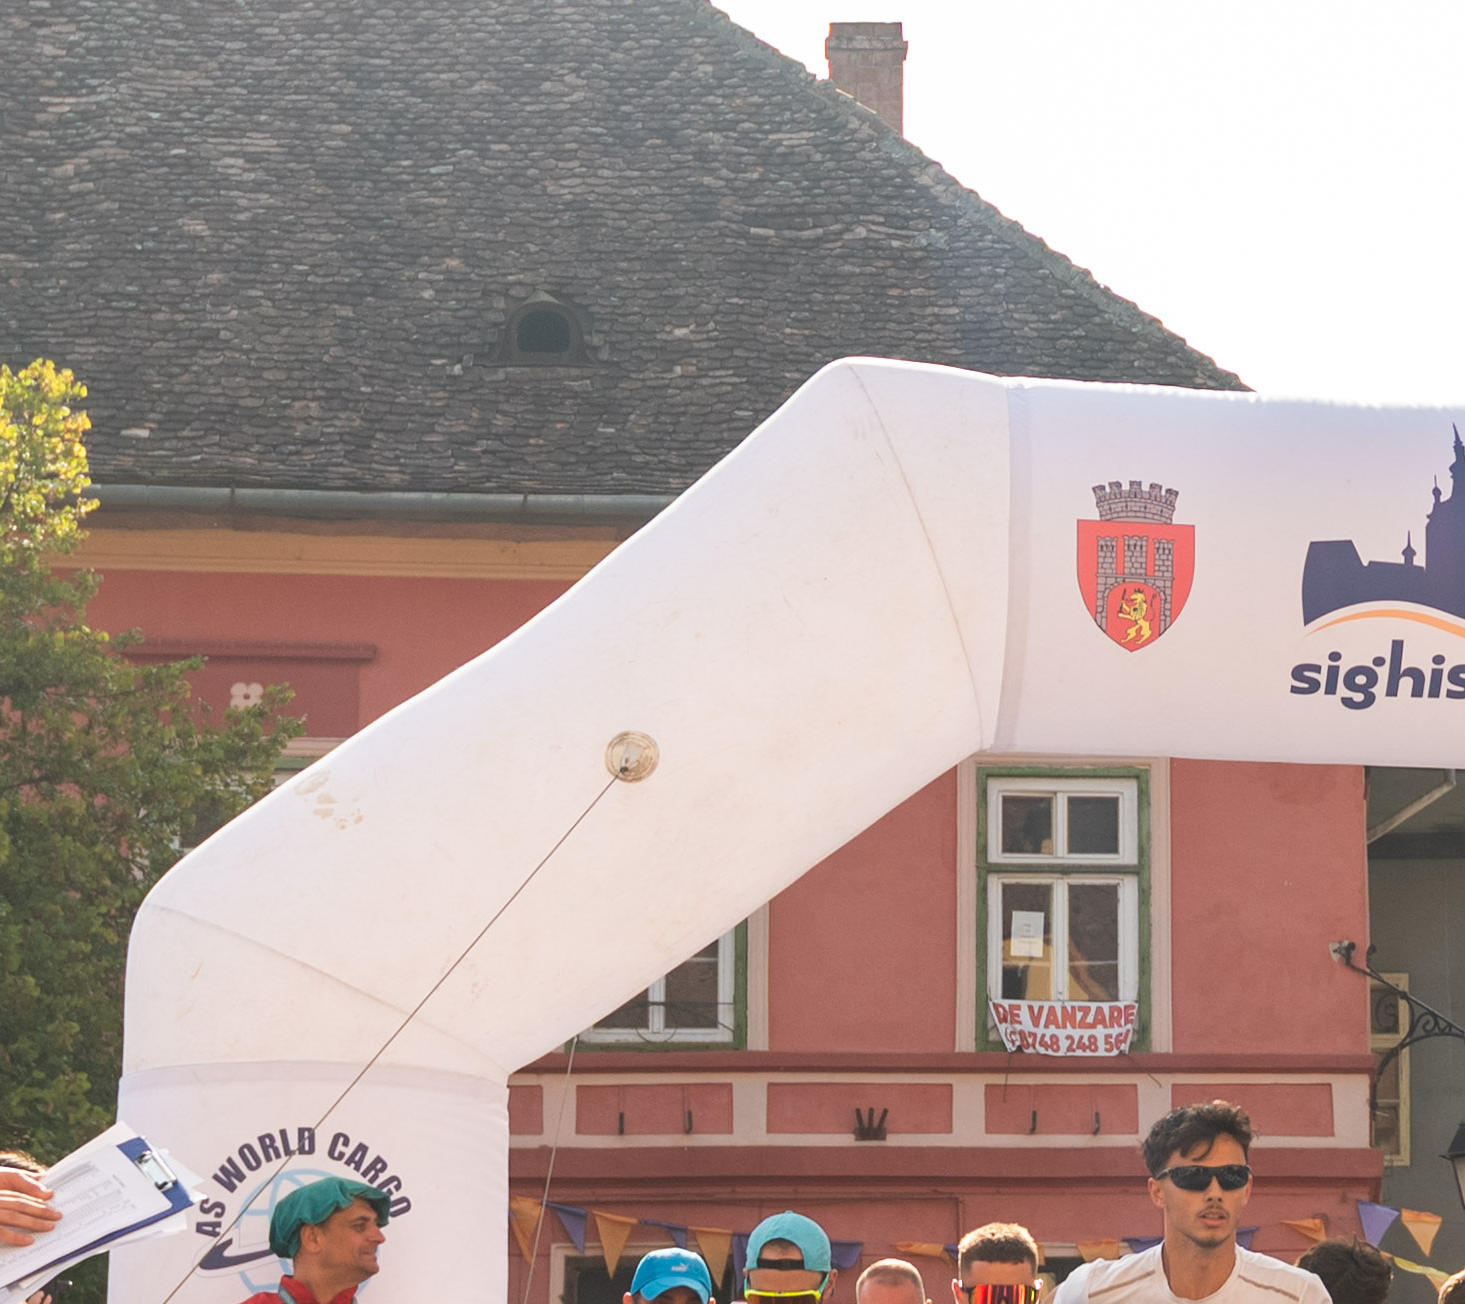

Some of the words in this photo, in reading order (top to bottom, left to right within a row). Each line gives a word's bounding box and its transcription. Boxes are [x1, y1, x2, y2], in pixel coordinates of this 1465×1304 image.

[993, 1002, 1023, 1026] DE
[1028, 1003, 1136, 1030] VANZARE
[1065, 1034, 1099, 1054] 248
[195, 1197, 226, 1238] AS
[212, 1127, 316, 1193] WORLD
[327, 1132, 412, 1218] CARGO
